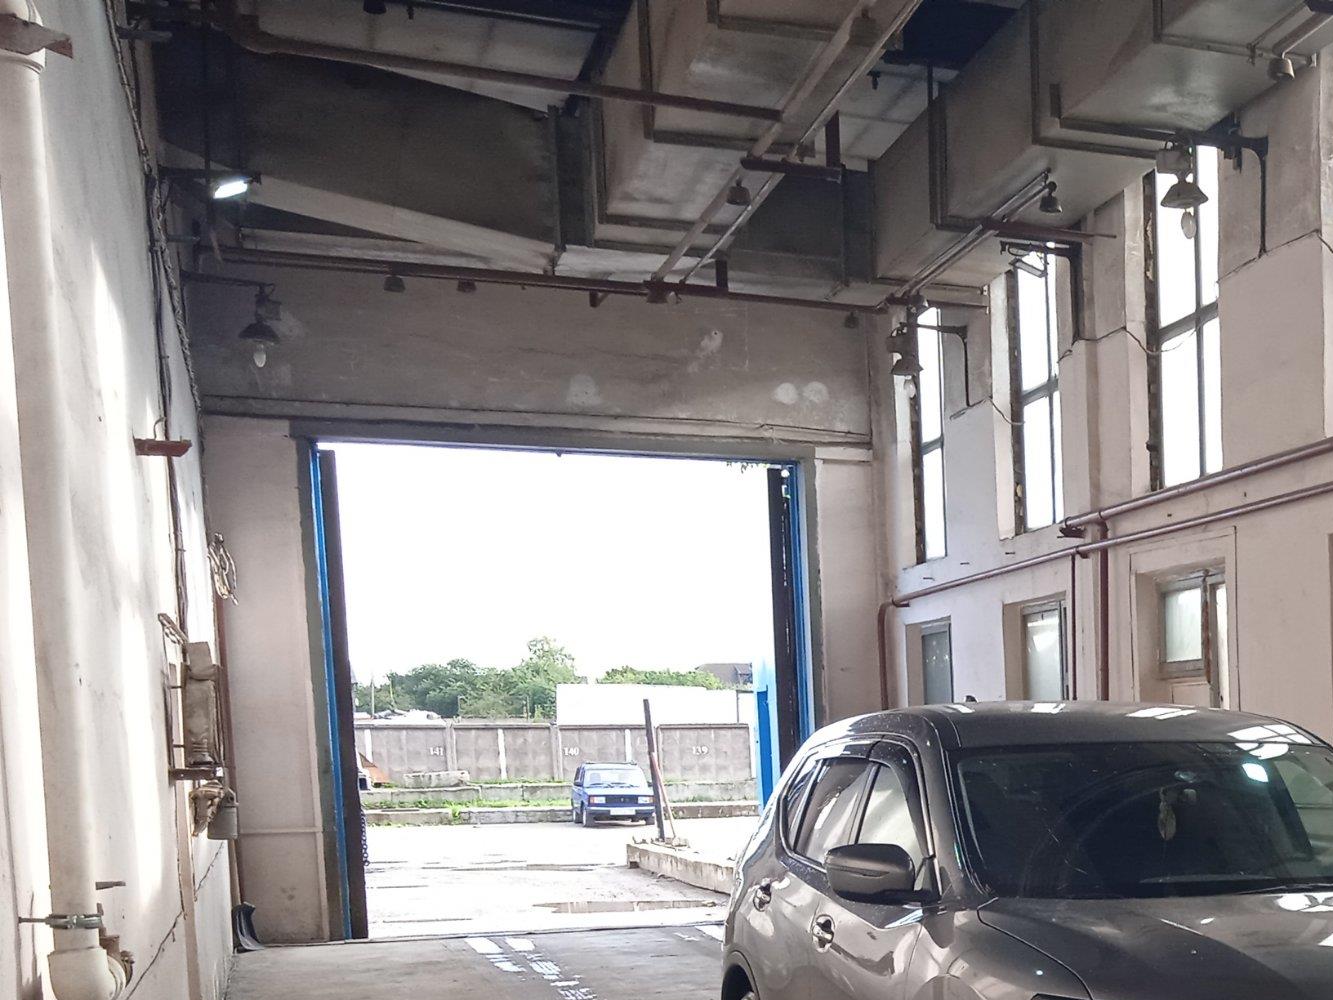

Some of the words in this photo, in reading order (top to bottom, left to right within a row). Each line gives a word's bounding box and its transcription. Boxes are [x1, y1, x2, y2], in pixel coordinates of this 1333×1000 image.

[429, 746, 444, 756] 141
[564, 746, 580, 756] 140
[692, 746, 709, 756] 139
